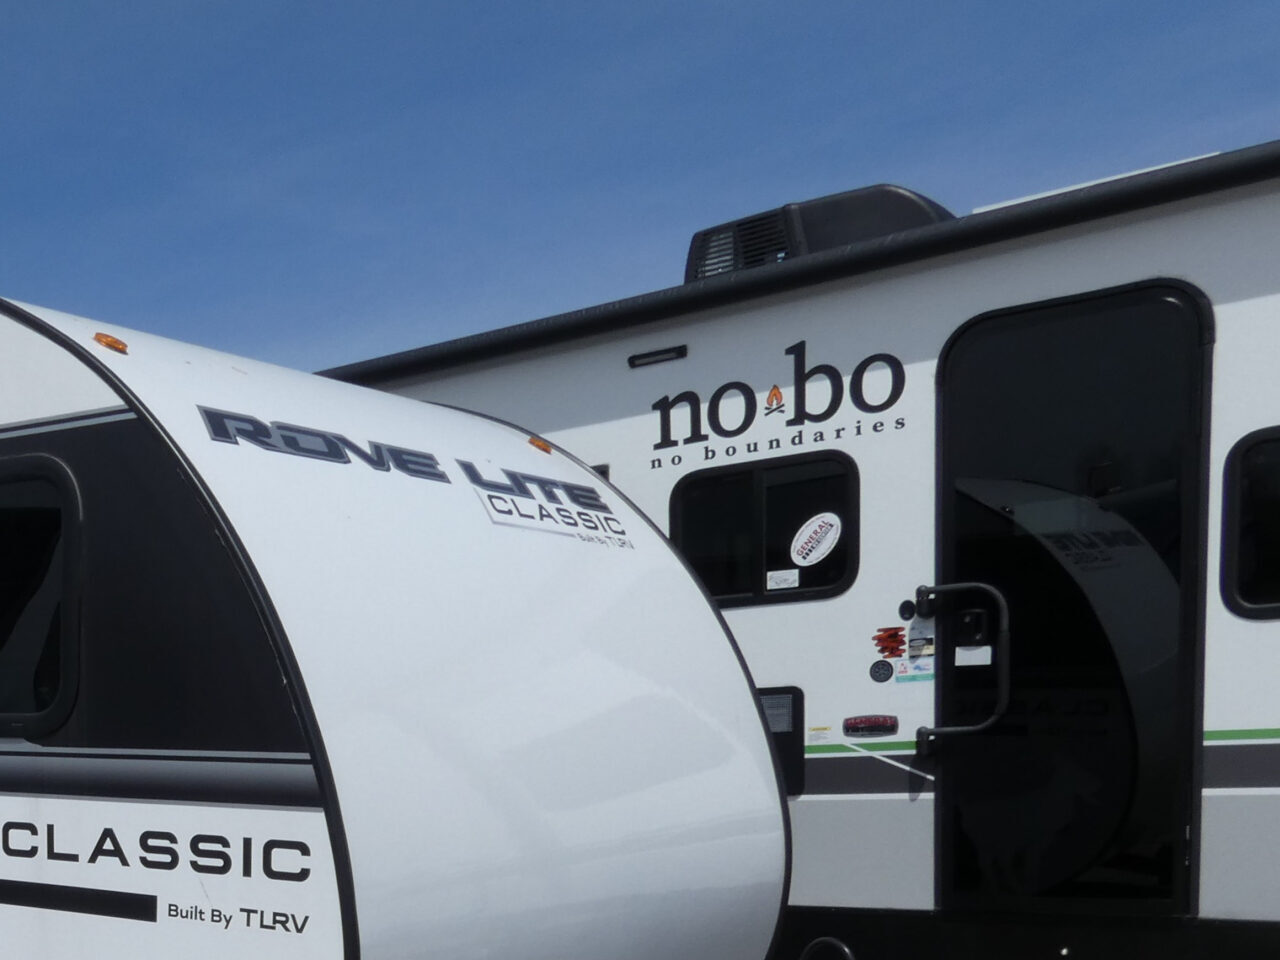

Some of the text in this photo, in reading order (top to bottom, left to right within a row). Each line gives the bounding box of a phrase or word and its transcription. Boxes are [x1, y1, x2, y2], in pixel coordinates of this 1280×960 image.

[651, 340, 906, 450] no bo
[196, 404, 613, 514] ROVE LITE
[650, 417, 906, 469] no boundaries
[487, 494, 626, 535] CLASSIC
[796, 520, 830, 556] GENERAL
[1, 821, 311, 882] CLASSIC
[168, 904, 310, 934] Built By TLRV
